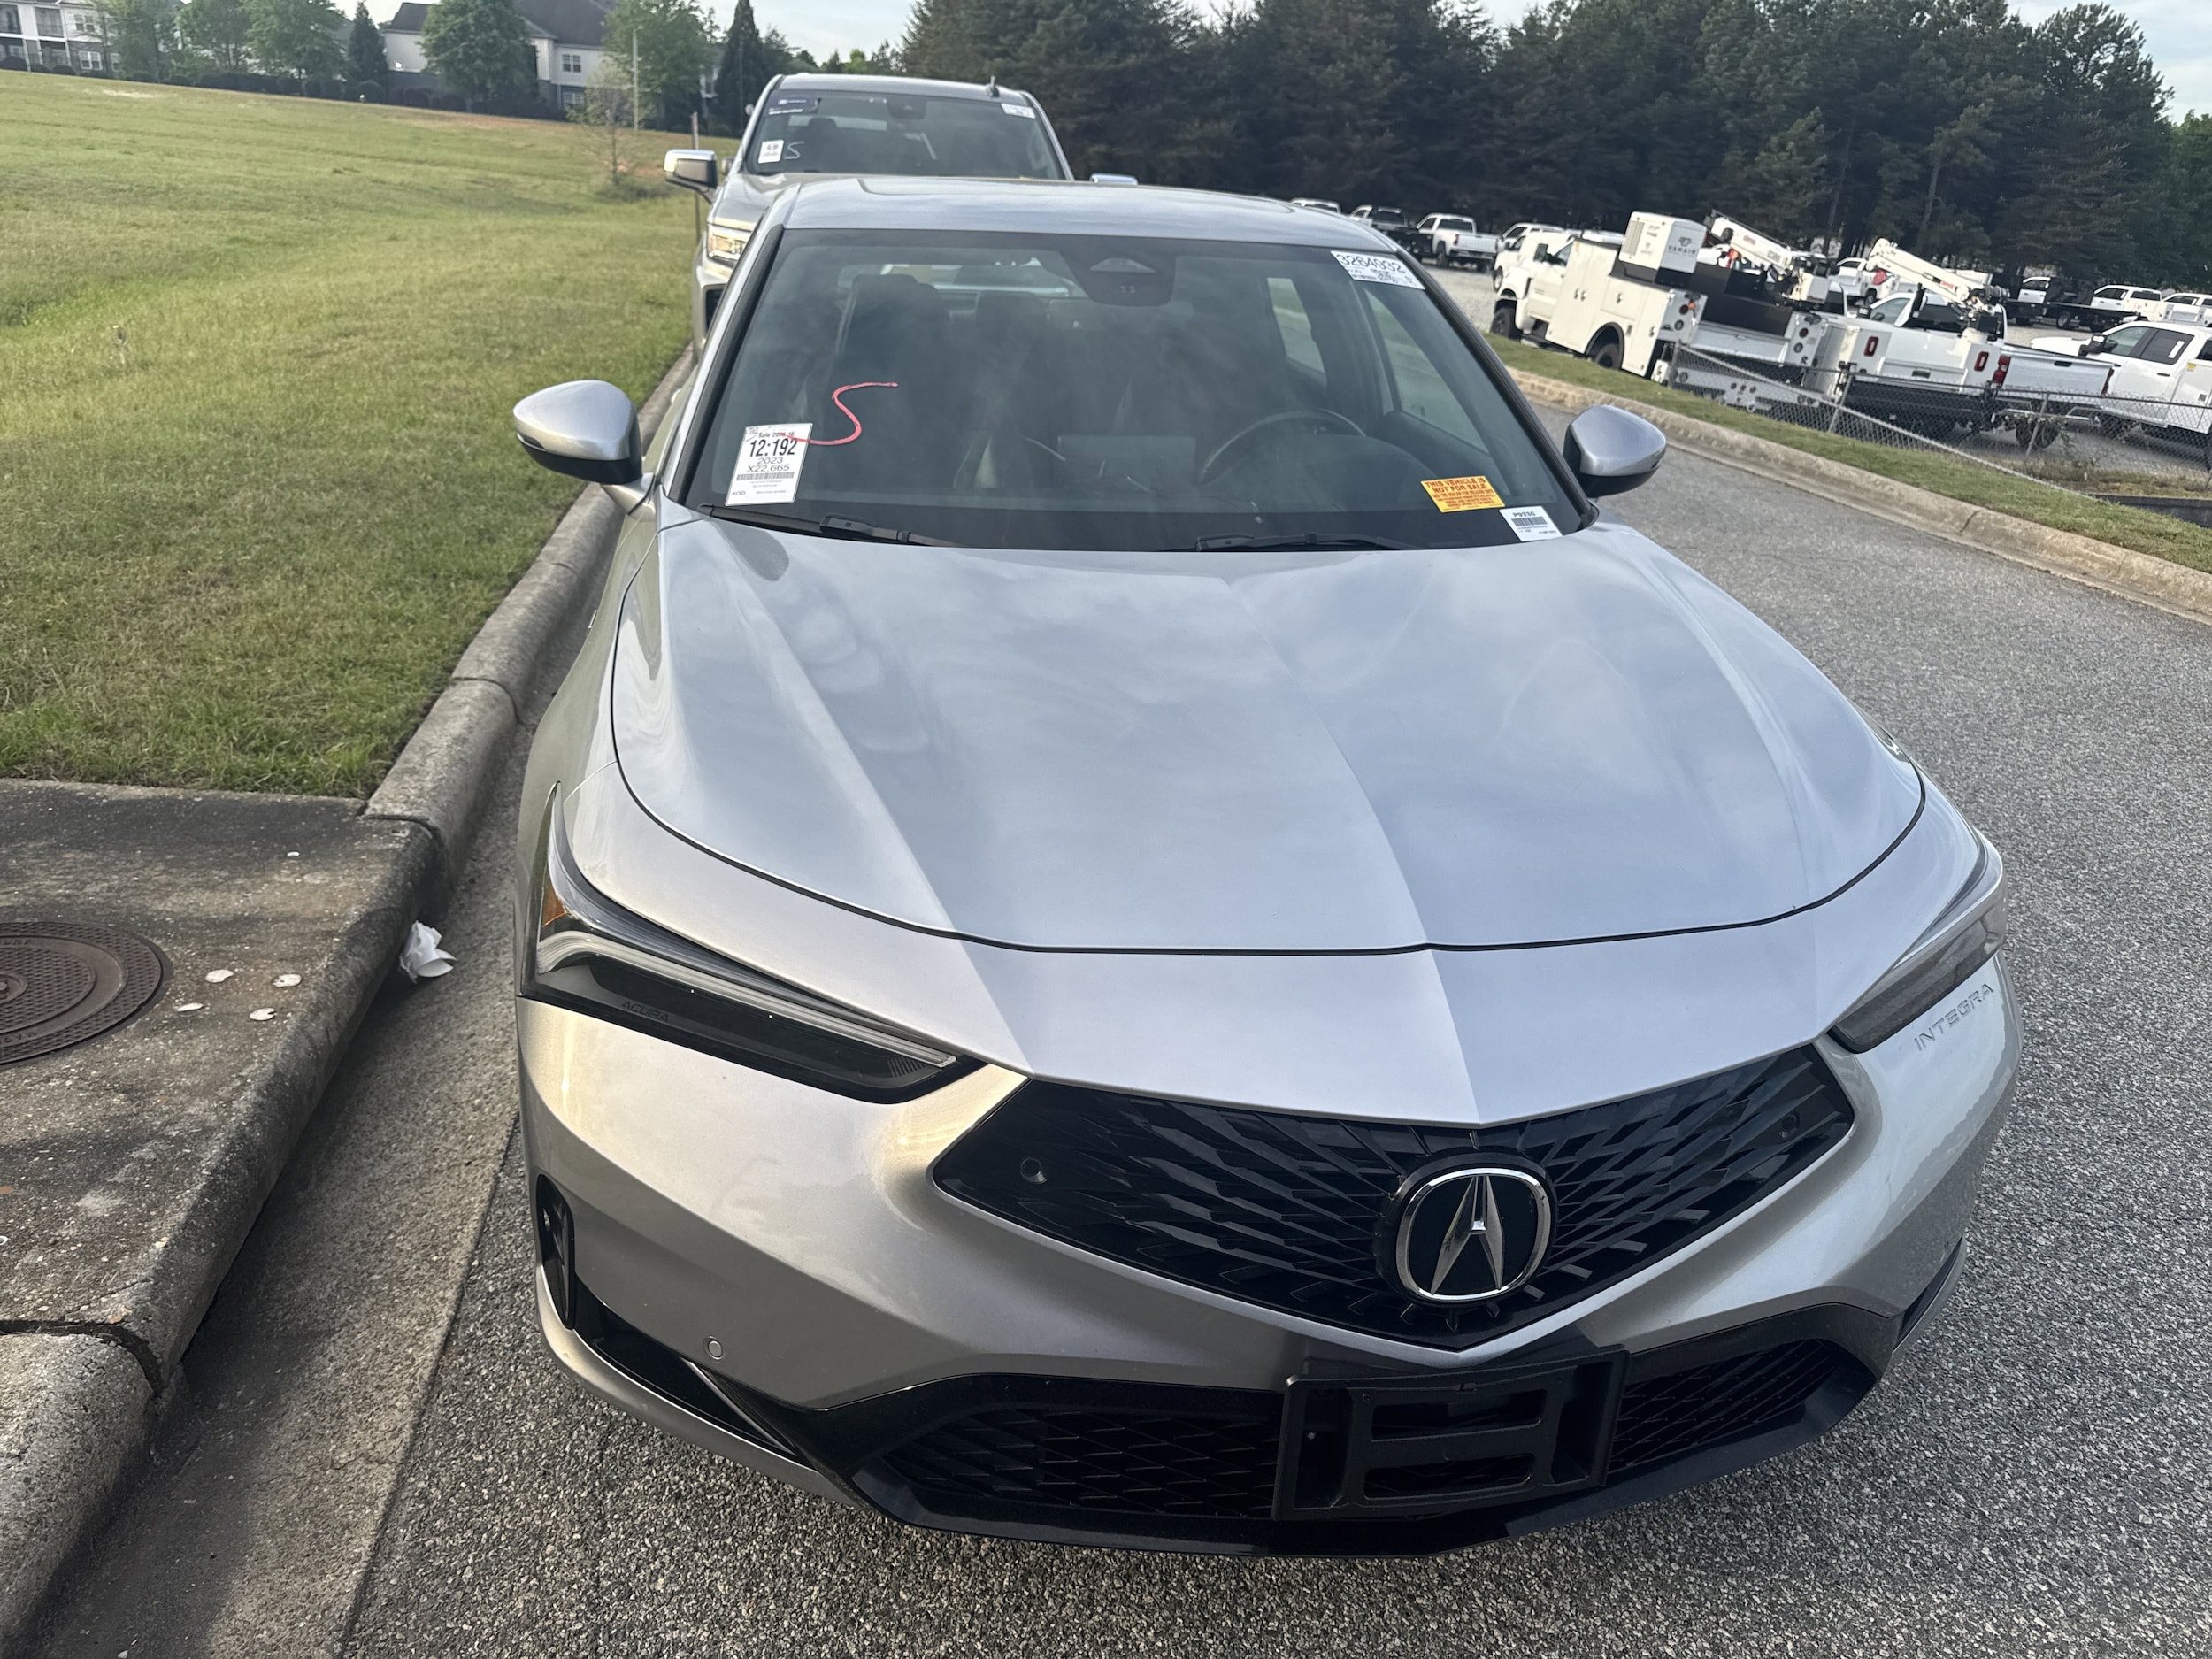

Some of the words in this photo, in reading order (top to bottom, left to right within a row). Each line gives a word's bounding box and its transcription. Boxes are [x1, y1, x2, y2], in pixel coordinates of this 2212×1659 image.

[749, 438, 798, 457] 12:192
[747, 464, 790, 473] X22,665
[622, 1001, 669, 1022] ACURA
[1914, 983, 1993, 1051] INTEGRA
